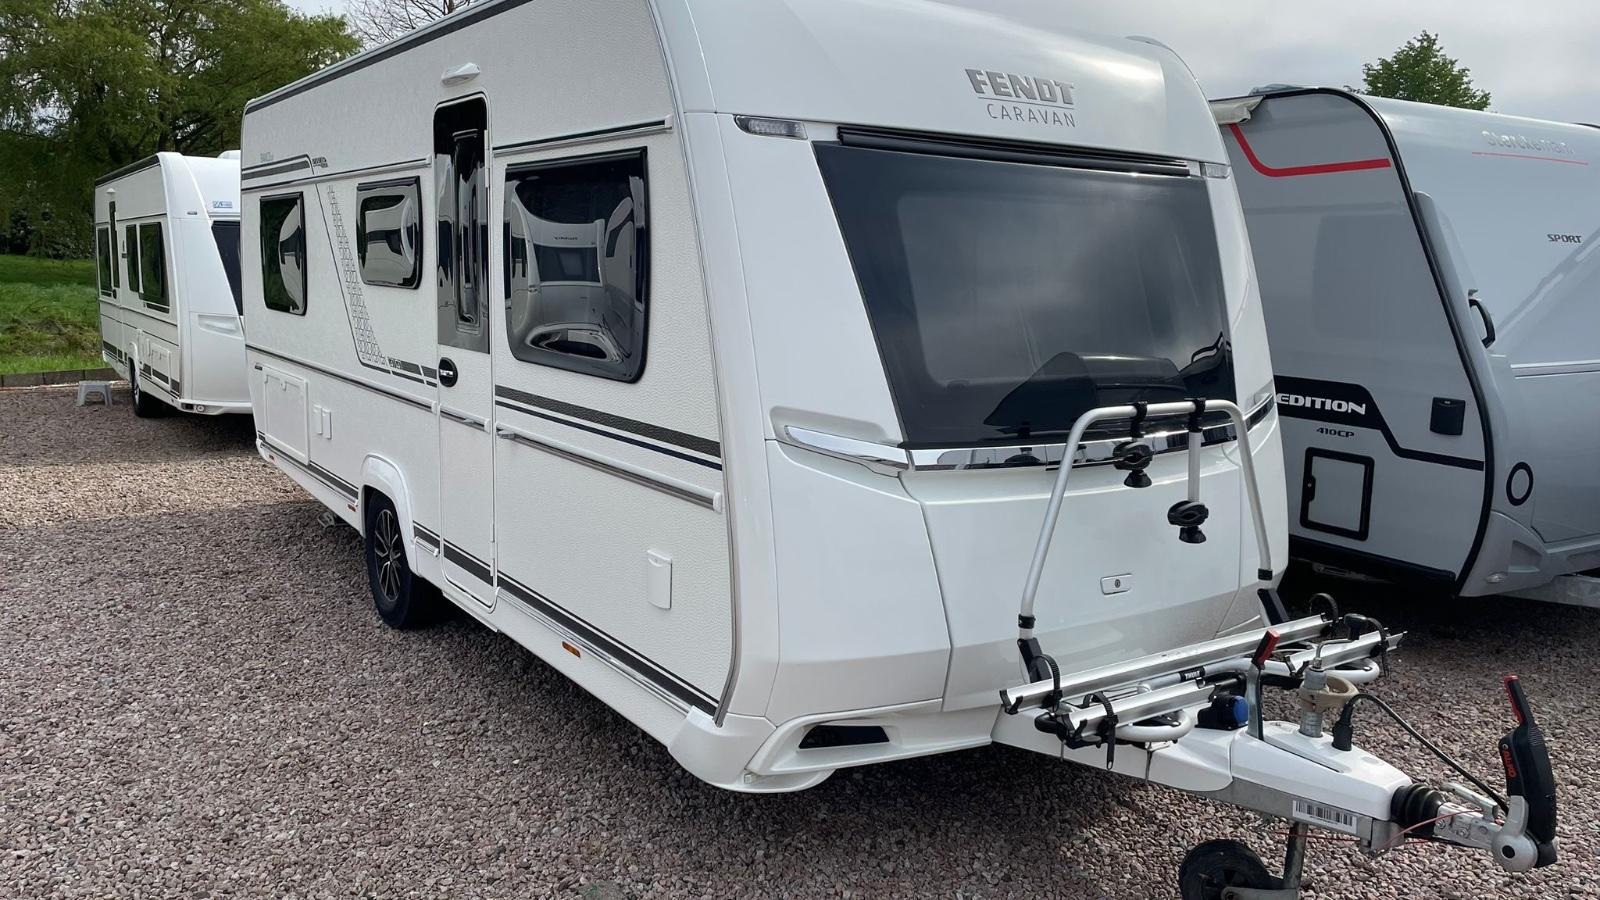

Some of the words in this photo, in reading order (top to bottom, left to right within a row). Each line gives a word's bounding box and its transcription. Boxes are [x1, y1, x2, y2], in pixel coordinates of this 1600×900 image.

[965, 68, 1074, 105] FENDT
[986, 103, 1076, 127] CARAVAN
[1547, 233, 1582, 244] SPORT
[1276, 392, 1366, 415] EDITION
